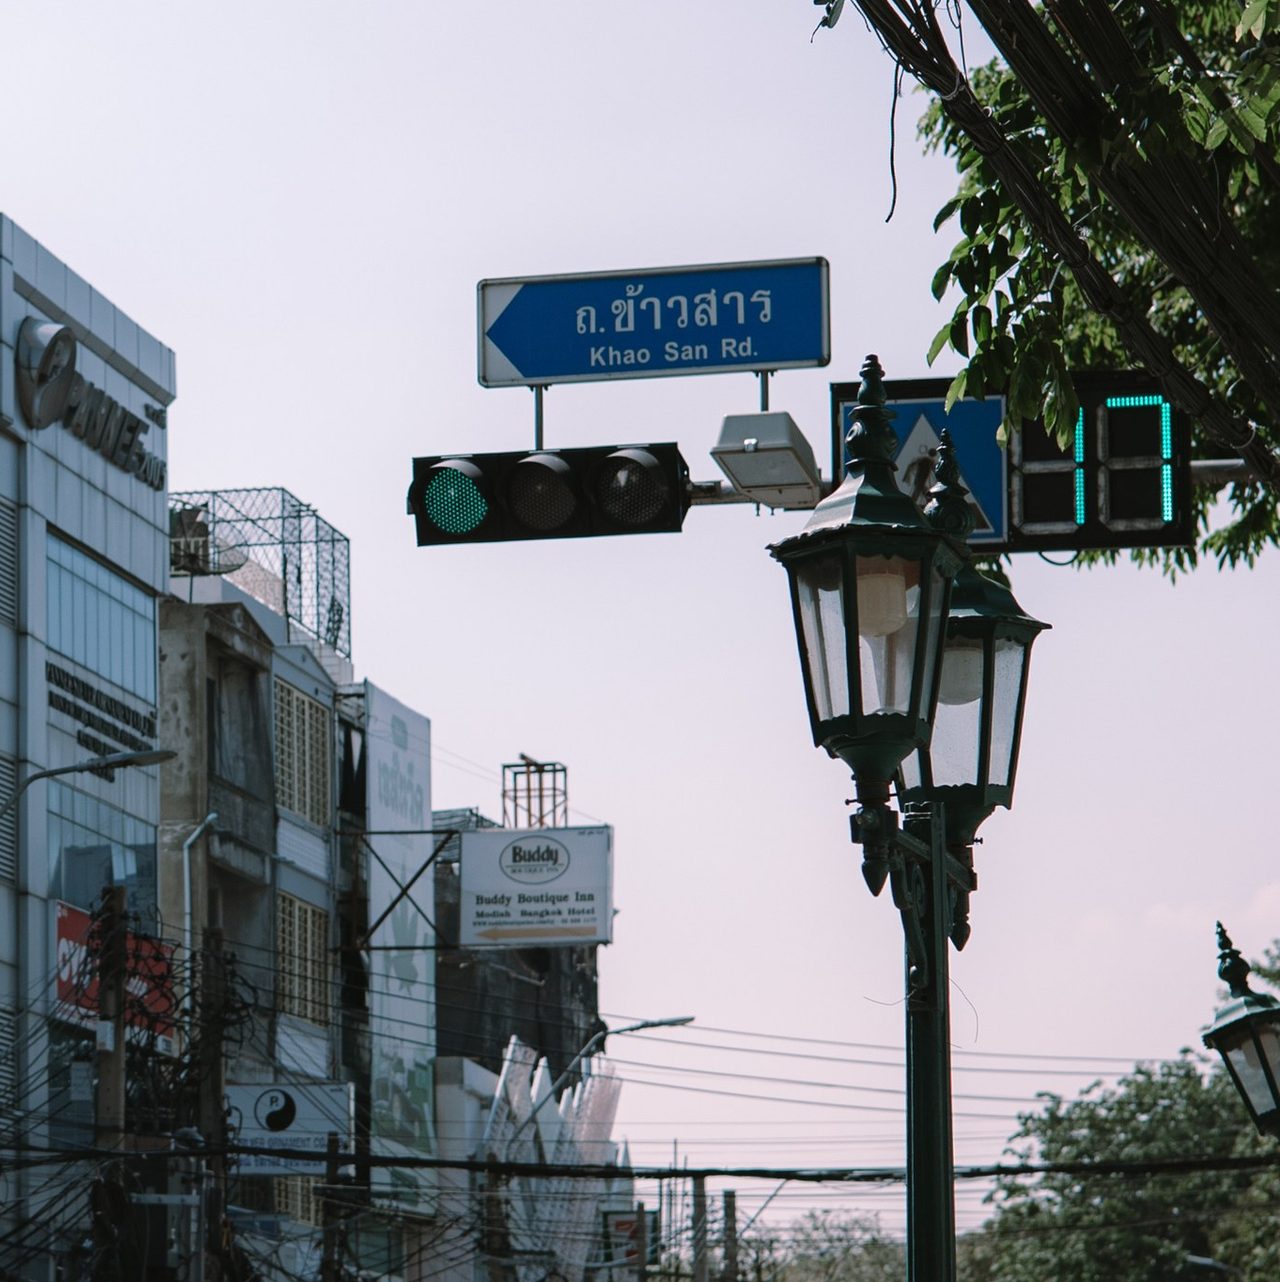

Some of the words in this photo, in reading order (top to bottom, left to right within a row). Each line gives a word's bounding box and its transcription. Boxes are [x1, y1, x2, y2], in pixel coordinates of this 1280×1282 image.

[590, 345, 651, 367] Khao
[664, 341, 708, 362] San
[721, 336, 759, 359] Rd.
[511, 845, 560, 866] Buddy
[475, 894, 512, 907] Buddy
[517, 892, 569, 906] Boutique
[575, 891, 595, 902] Inn
[520, 908, 563, 919] Bangkok
[568, 906, 596, 916] Hotel
